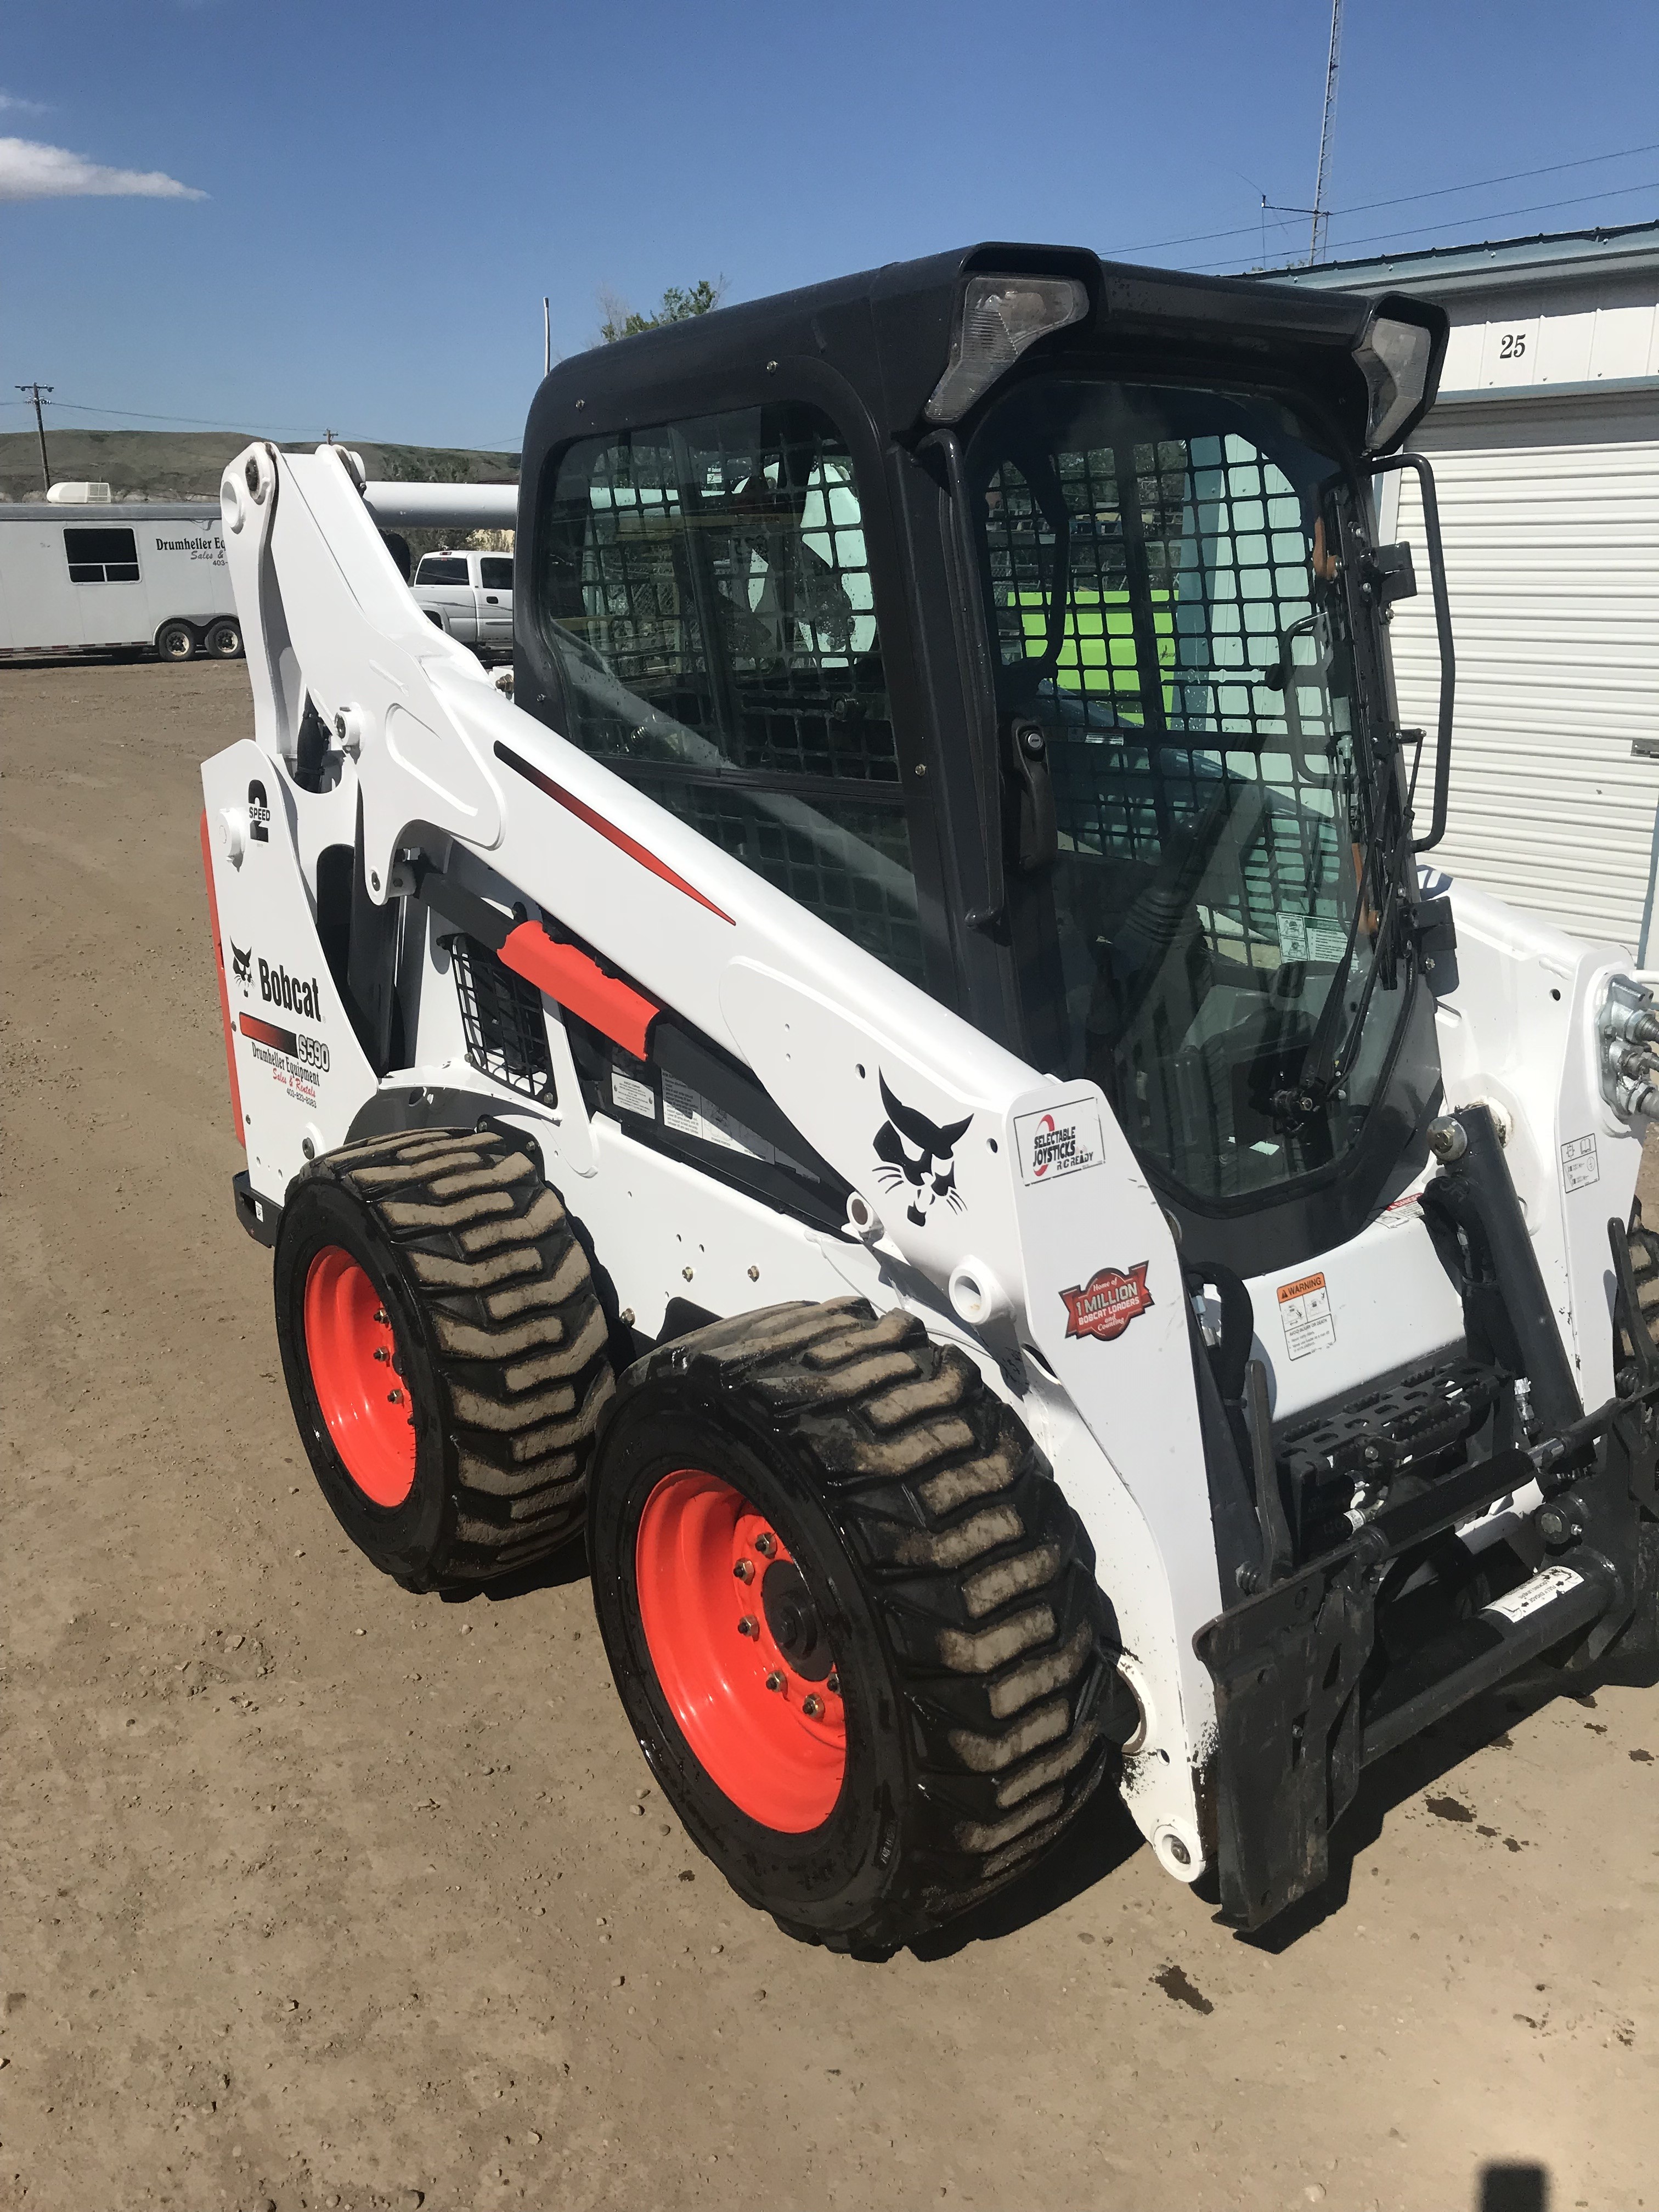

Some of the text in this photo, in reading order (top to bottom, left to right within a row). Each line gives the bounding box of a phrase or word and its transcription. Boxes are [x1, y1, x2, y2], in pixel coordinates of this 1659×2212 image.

[1499, 334, 1526, 359] 25
[155, 538, 212, 550] Drumheller
[190, 550, 224, 560] Sales &
[249, 806, 270, 821] SPEED
[258, 957, 321, 1023] Bobcat
[251, 1041, 320, 1087] Drumheller Equipment
[298, 1034, 330, 1073] S590
[272, 1068, 287, 1084] Sales
[295, 1078, 316, 1098] Rentals
[1034, 1126, 1076, 1149] SELECTABLE
[1032, 1139, 1076, 1167] JOYSTICKS
[1093, 1277, 1118, 1293] Home of
[1288, 1277, 1322, 1296] WARNING
[1076, 1281, 1138, 1316] 1 MILLION
[1078, 1296, 1140, 1325] BOBCAT LOADERS
[1097, 1317, 1125, 1331] Counting
[1104, 1313, 1116, 1323] and
